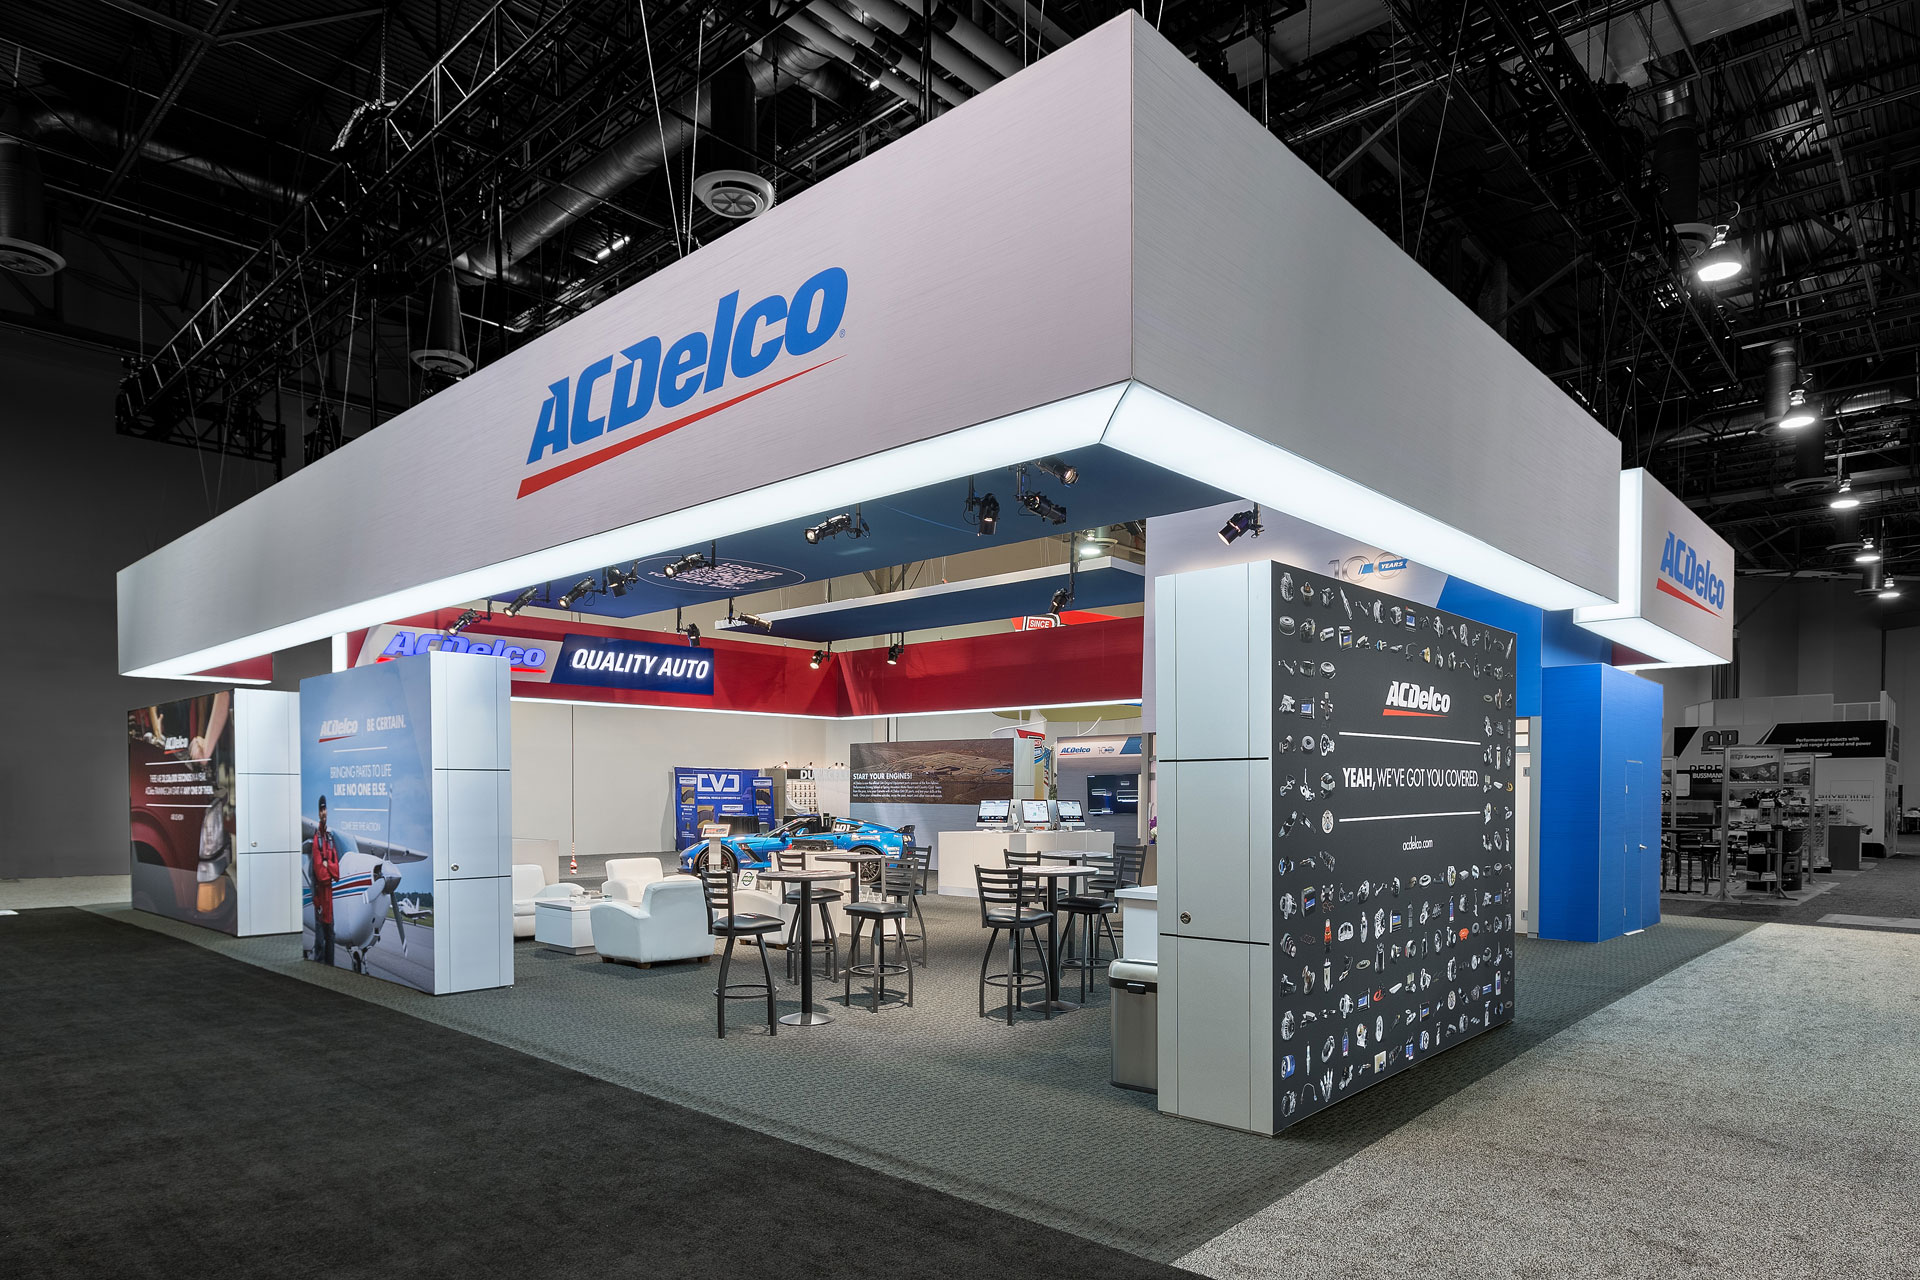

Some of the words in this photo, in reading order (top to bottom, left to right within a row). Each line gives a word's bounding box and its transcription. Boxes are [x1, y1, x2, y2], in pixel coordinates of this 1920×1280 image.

[526, 266, 848, 465] ACDelco
[1380, 561, 1404, 570] YEARS
[1660, 530, 1725, 610] ACDelco
[1029, 619, 1050, 629] SINCE
[572, 648, 656, 675] QUALITY
[659, 653, 709, 679] AUTO
[1385, 680, 1451, 713] ACDelco
[320, 717, 358, 737] ACDelco
[366, 718, 375, 732] BE
[376, 714, 407, 731] CERTAIN.
[1060, 746, 1091, 754] ACDelco
[330, 764, 356, 779] BRINGING
[356, 764, 372, 778] PARTS
[372, 764, 381, 777] TO
[381, 763, 392, 777] LIFE
[886, 772, 913, 780] ENGINES!
[1342, 767, 1376, 790] YEAH,
[1406, 768, 1426, 788] GOT
[1426, 767, 1444, 787] YOU
[1444, 767, 1480, 788] COVERED.
[334, 783, 346, 796] LIKE
[346, 783, 357, 796] NO
[357, 782, 372, 796] ONE
[372, 782, 388, 796] ELSE.
[1402, 835, 1434, 851] acdelco.com
